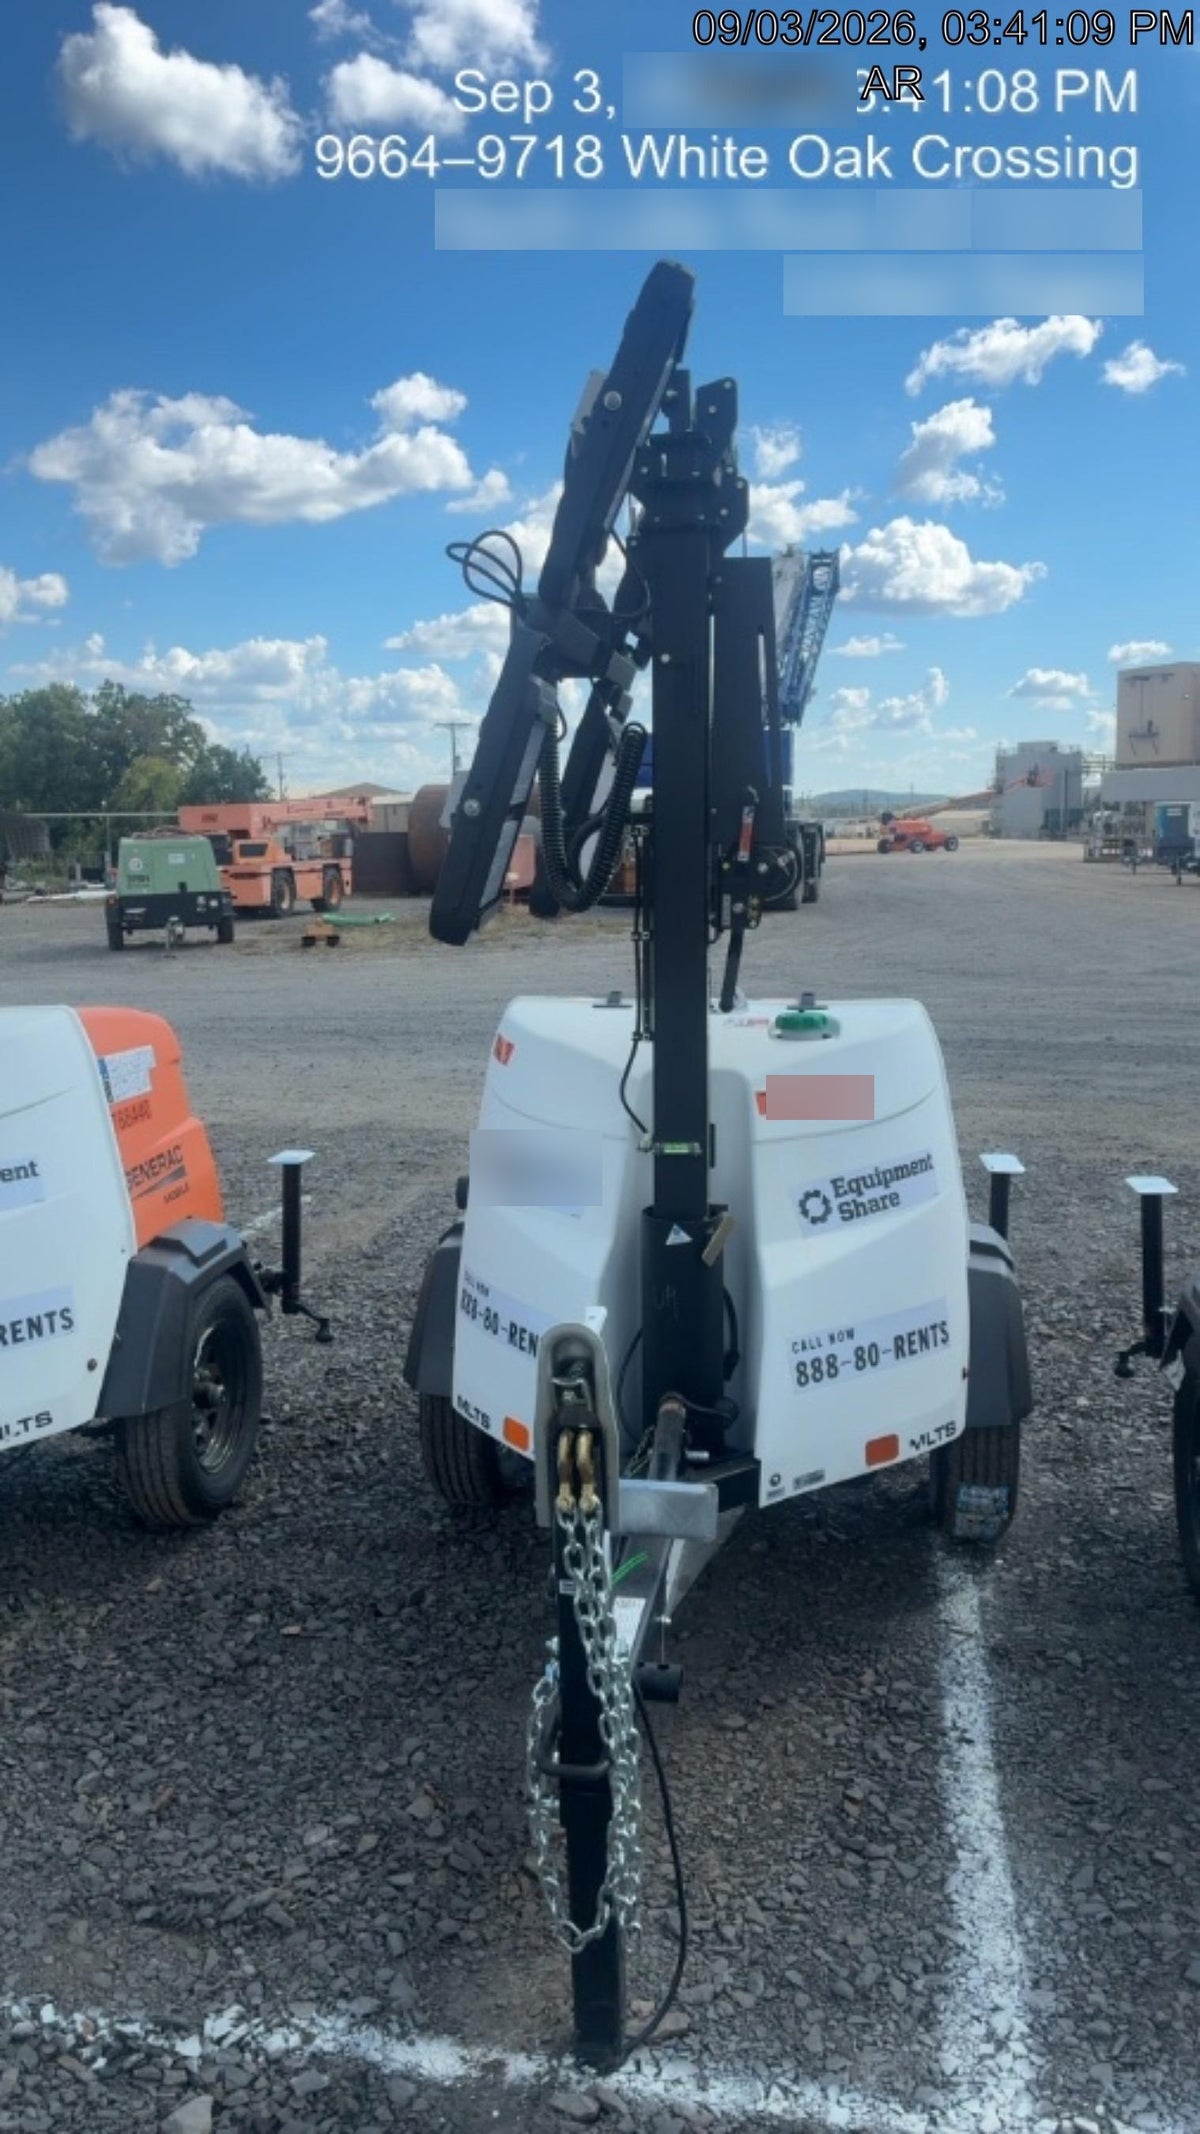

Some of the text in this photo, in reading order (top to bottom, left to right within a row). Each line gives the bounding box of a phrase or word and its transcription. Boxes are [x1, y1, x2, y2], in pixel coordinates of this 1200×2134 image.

[829, 1152, 934, 1199] Equipment
[837, 1191, 902, 1223] Share
[791, 1327, 855, 1354] CALL NOW
